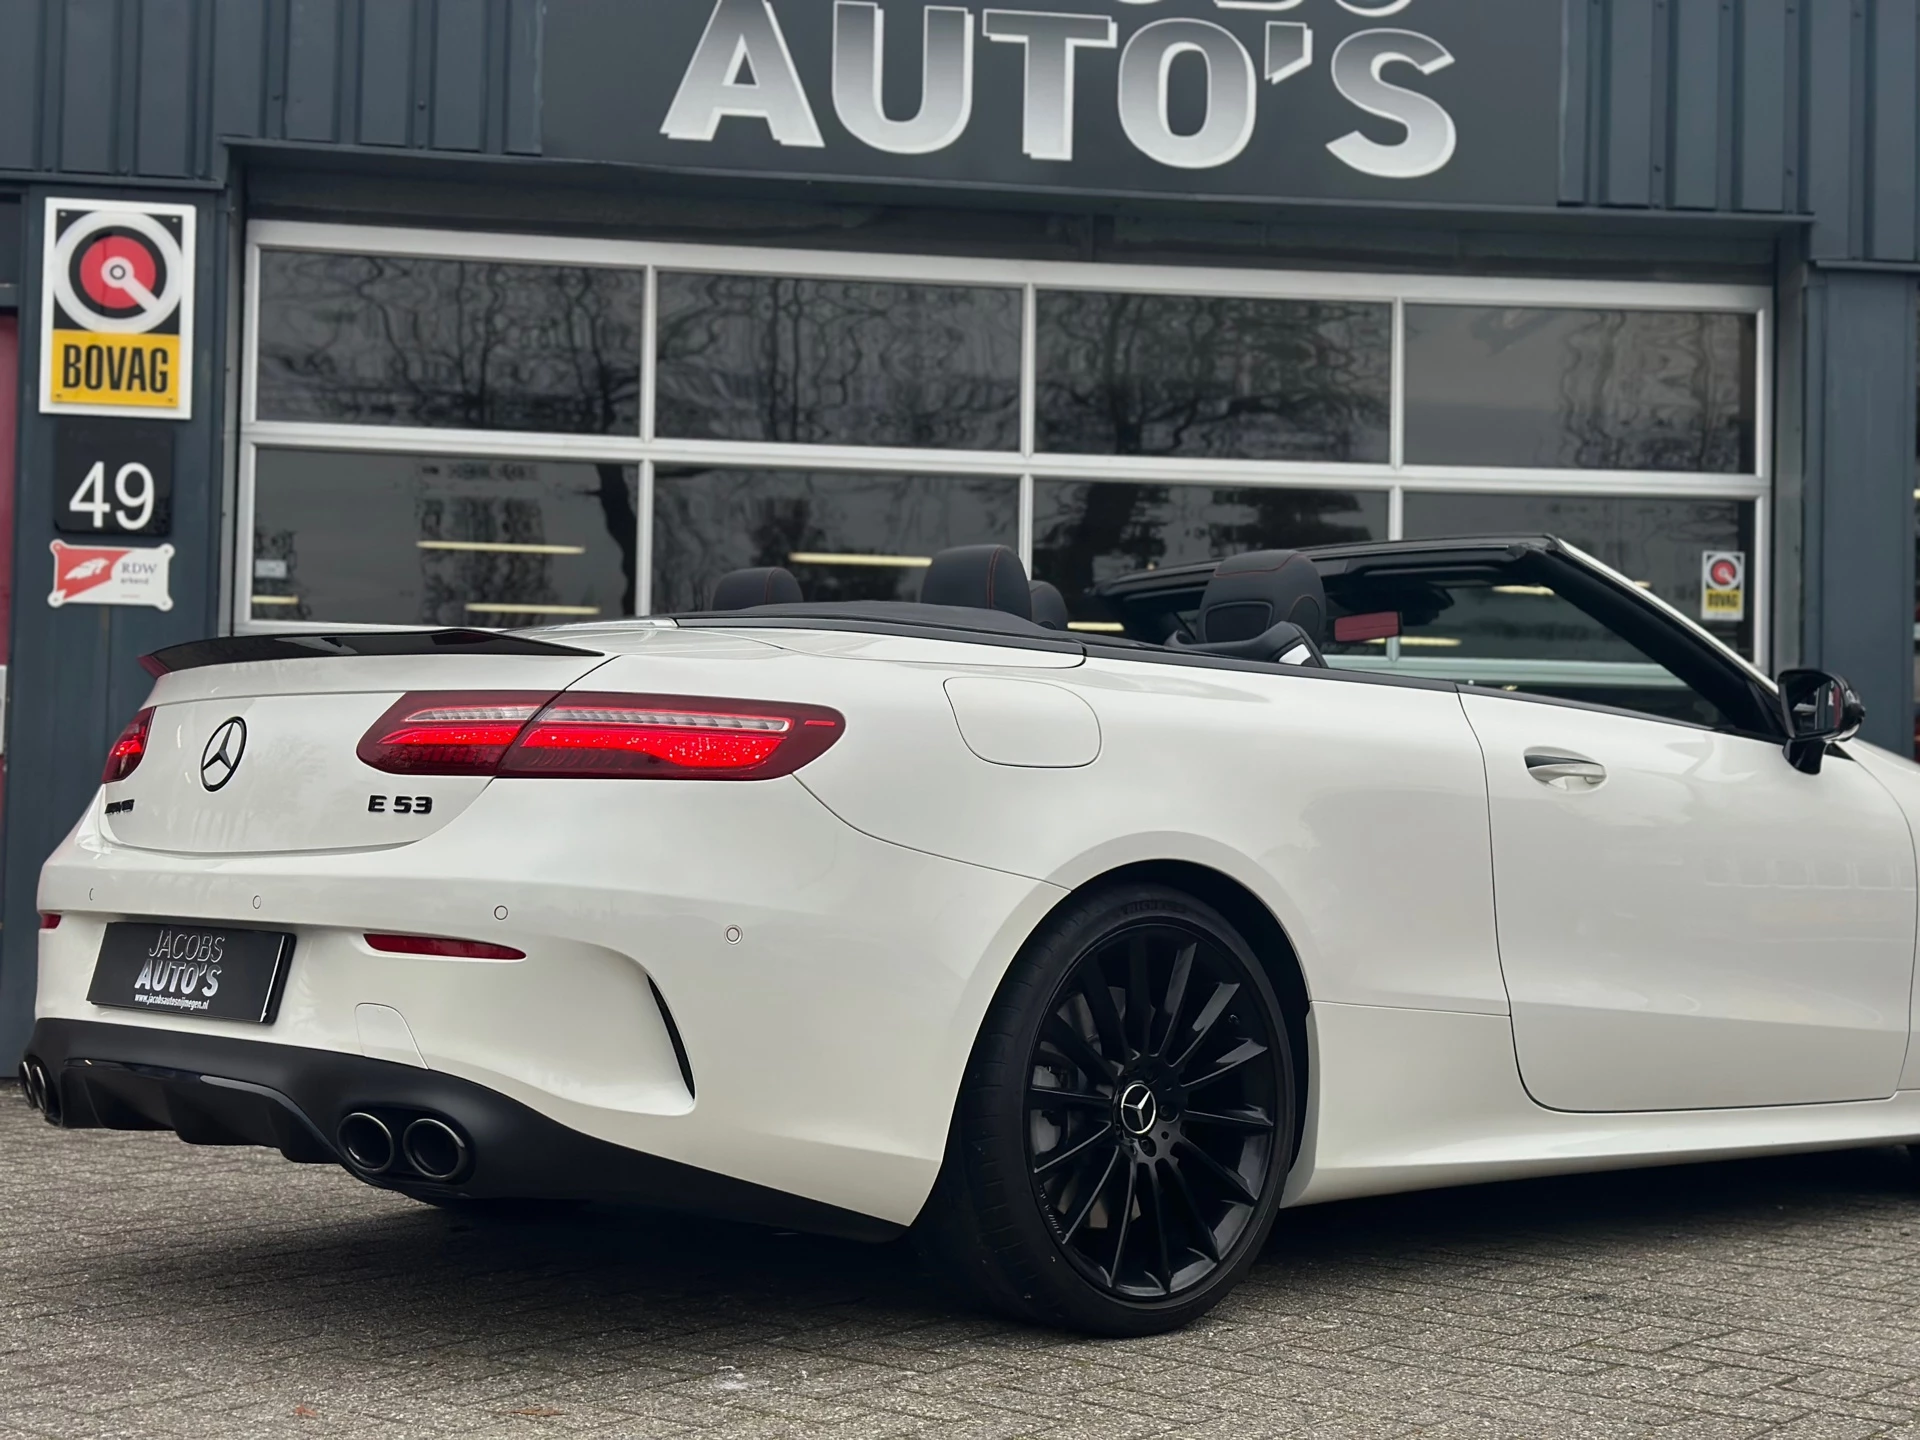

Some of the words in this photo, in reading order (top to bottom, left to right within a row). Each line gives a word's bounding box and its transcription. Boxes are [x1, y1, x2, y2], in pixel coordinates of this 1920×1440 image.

[660, 0, 1457, 178] AUTO'S
[63, 344, 169, 393] BOVAG
[69, 461, 155, 530] 49
[121, 562, 158, 574] RDW
[368, 795, 387, 812] E
[393, 796, 433, 814] 53
[149, 930, 225, 963] JACOBS
[134, 959, 222, 997] AUTO'S
